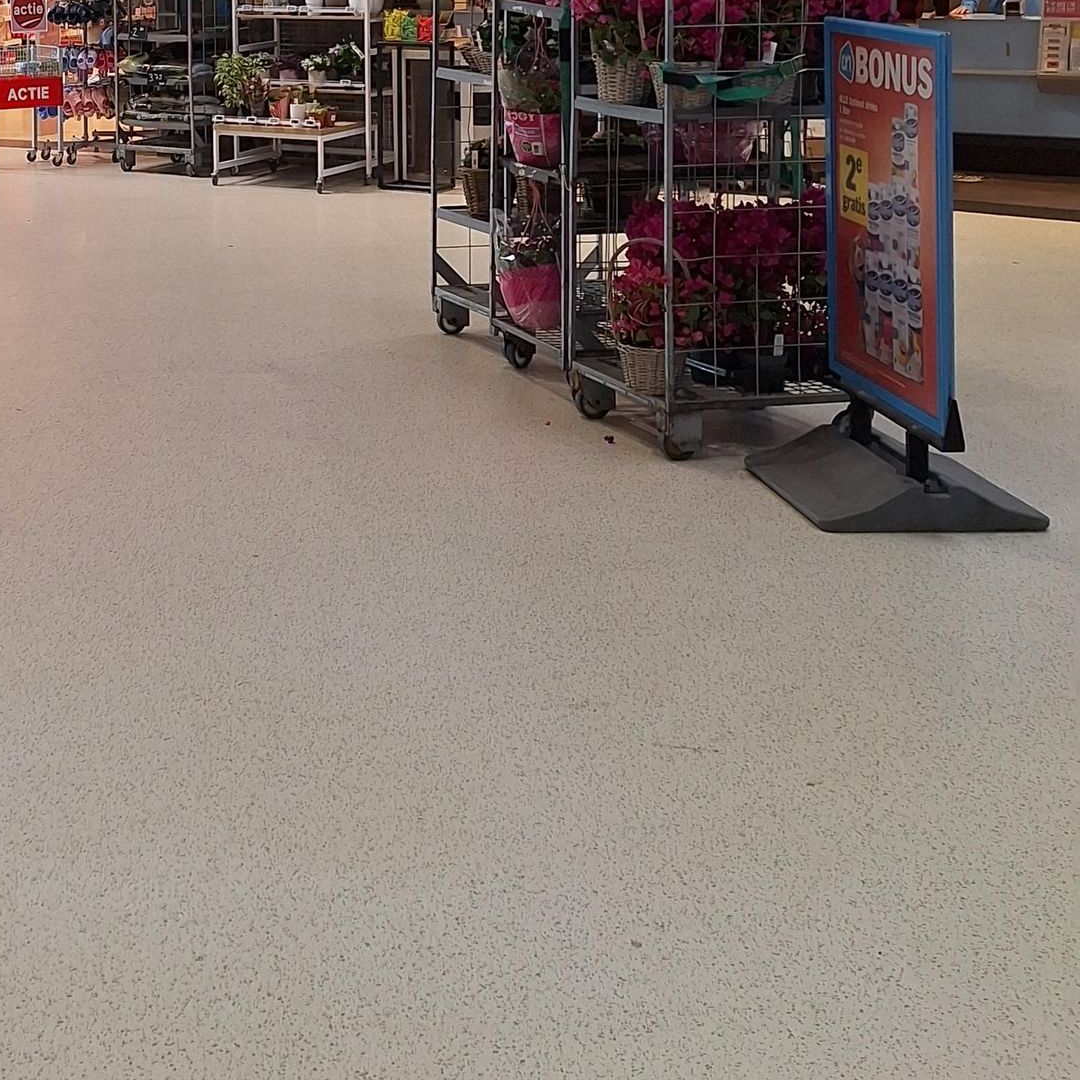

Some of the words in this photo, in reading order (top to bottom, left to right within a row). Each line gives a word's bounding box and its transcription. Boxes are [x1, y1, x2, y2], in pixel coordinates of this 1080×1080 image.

[13, 4, 45, 16] actie
[855, 45, 933, 100] BONUS
[7, 85, 50, 102] ACTIE
[841, 194, 866, 216] gratis
